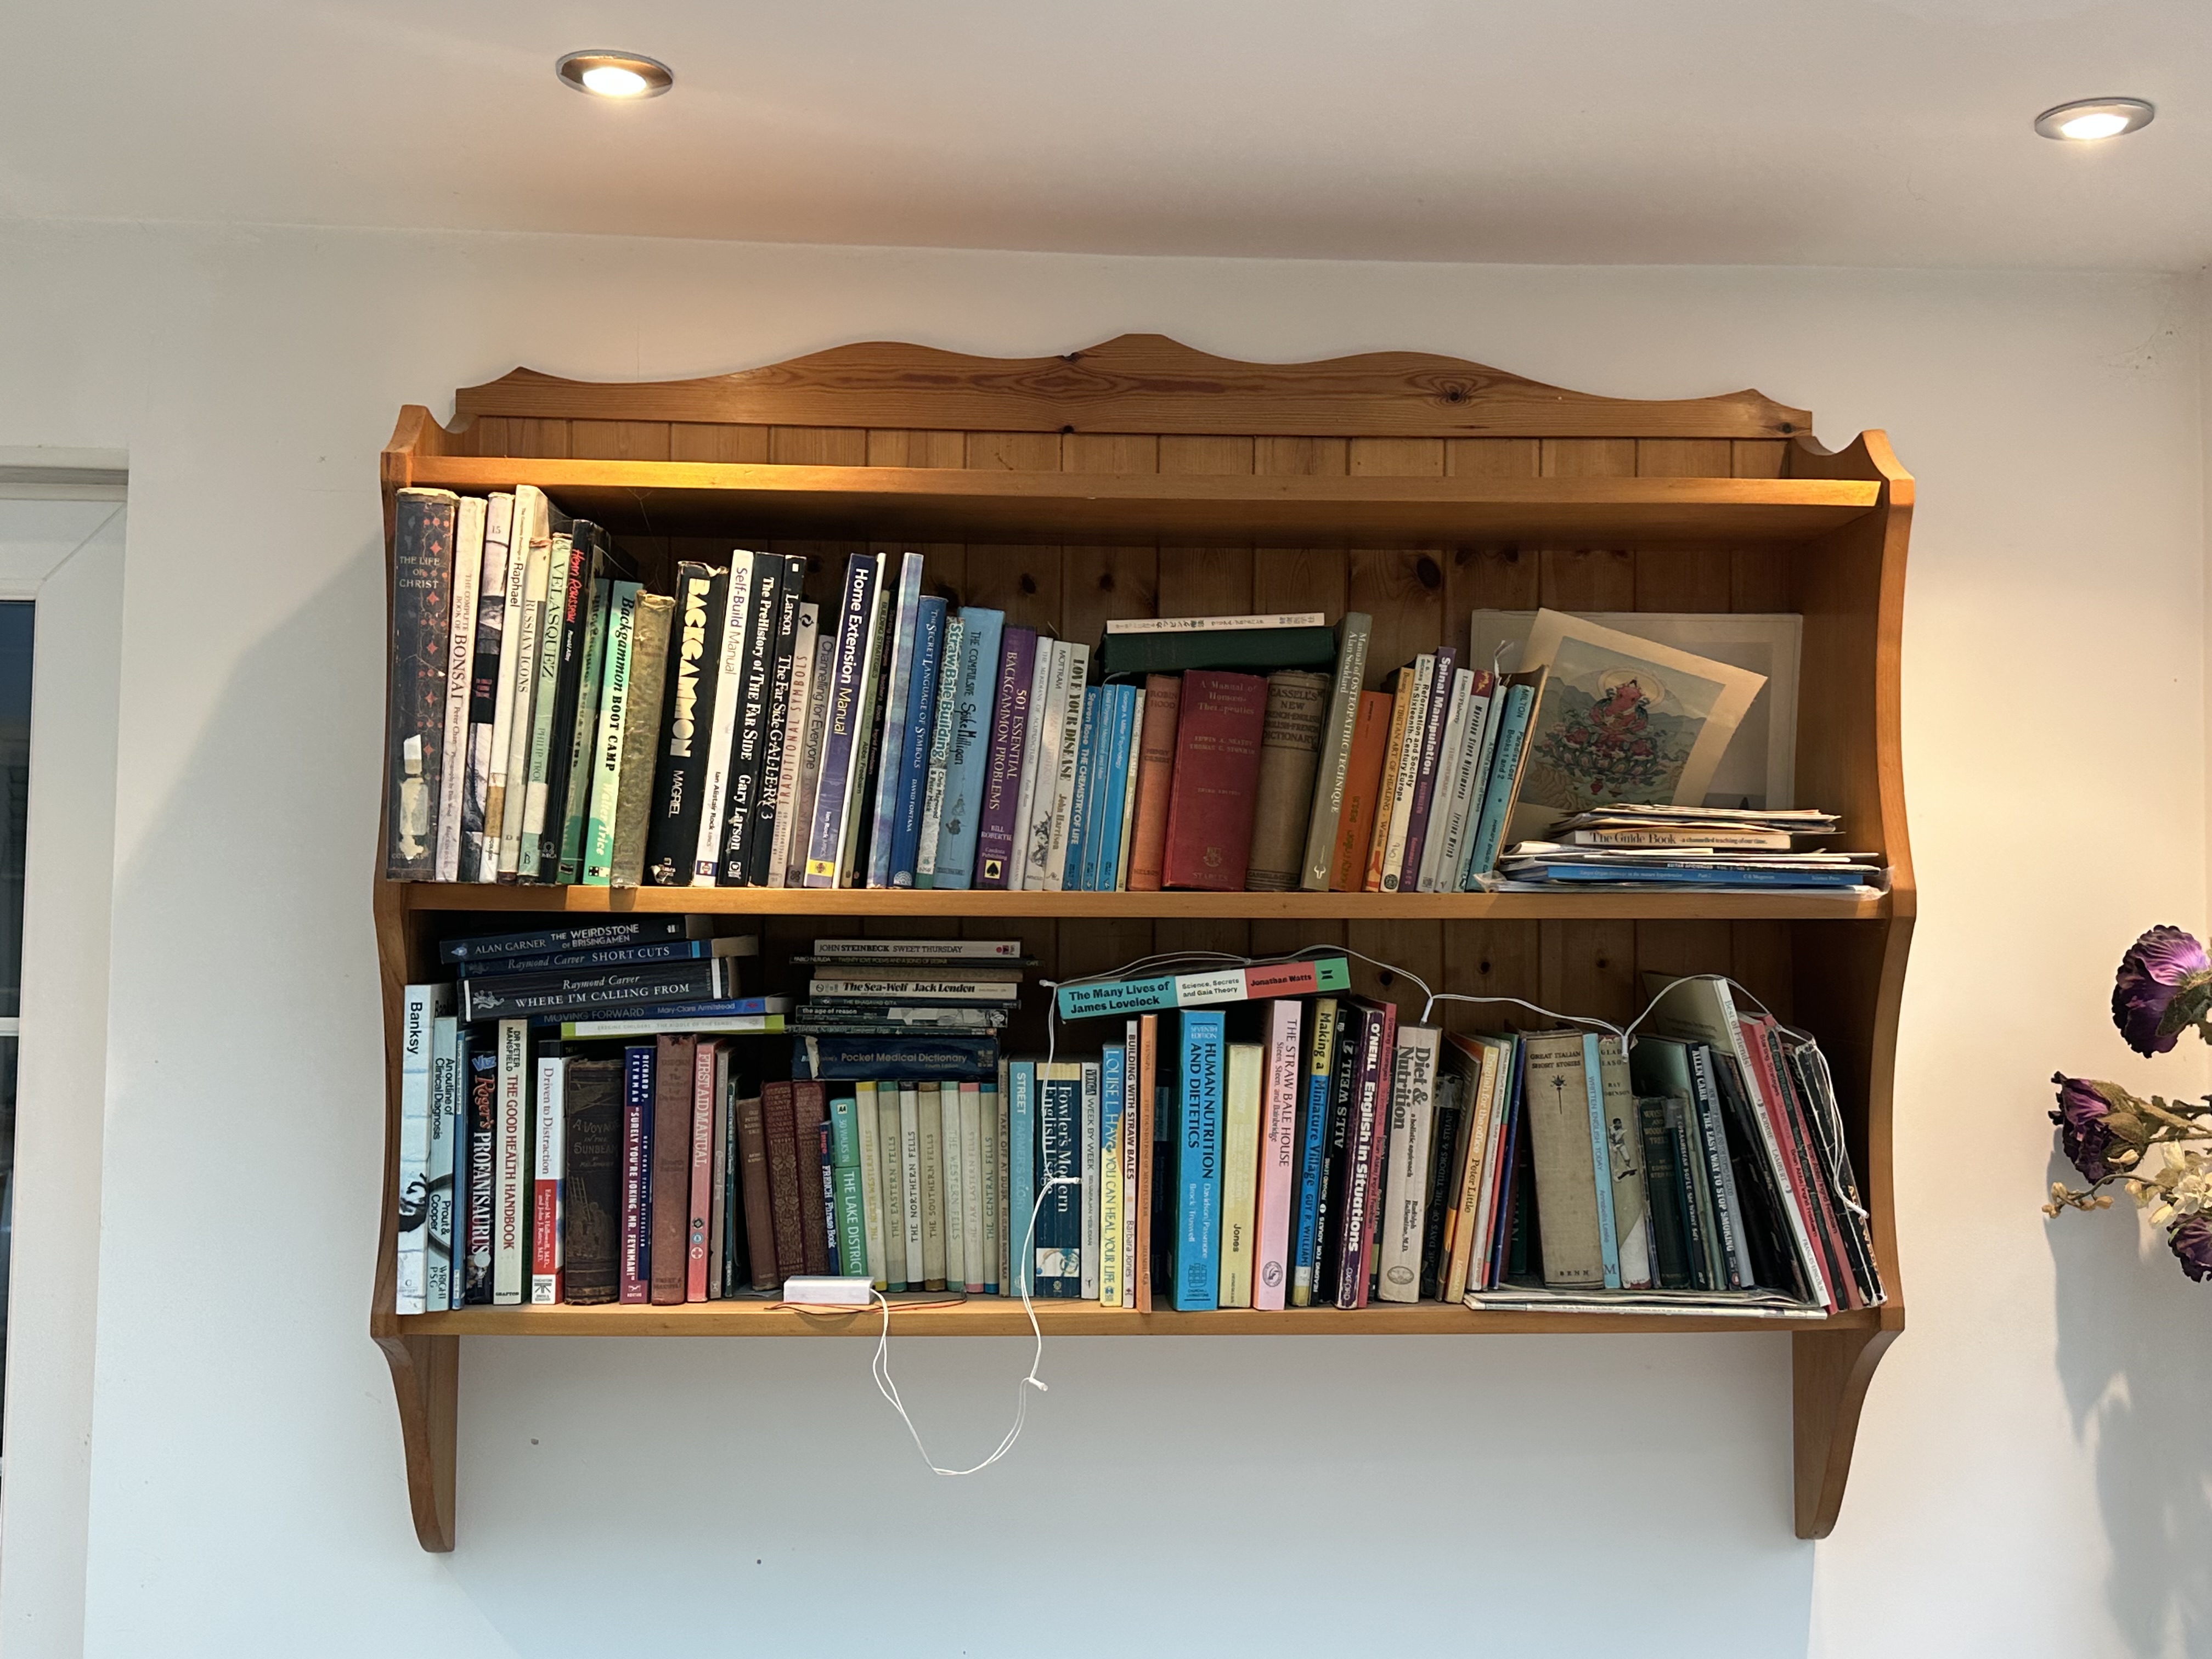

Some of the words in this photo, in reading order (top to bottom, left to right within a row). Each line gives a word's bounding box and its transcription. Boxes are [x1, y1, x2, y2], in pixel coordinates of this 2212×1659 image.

[400, 556, 417, 565] THE
[419, 557, 440, 566] LIFE
[399, 579, 439, 589] CHRIST
[510, 562, 523, 607] Raphael
[730, 567, 748, 628] Self-Build
[850, 568, 869, 612] Home
[455, 621, 461, 630] OF
[522, 600, 536, 650] RUSSIAN
[542, 562, 565, 679] VELASQUEZ
[613, 595, 635, 692] Backgammon
[724, 631, 742, 675] Manual
[840, 615, 862, 684] Extension
[926, 623, 938, 657] SECRET
[451, 634, 467, 699] BONSAI
[518, 656, 531, 693] ICONS
[670, 578, 710, 758] BACKGAMMON
[1055, 650, 1066, 690] MOTTRAM
[1070, 658, 1085, 691] LOVE
[1436, 657, 1451, 695] Spinal
[919, 659, 933, 710] LANGUAGE
[997, 651, 1018, 743] BACKGAMMON
[1015, 689, 1028, 710] 501
[1149, 690, 1177, 699] ROBIN
[1267, 689, 1317, 701] CASSELL'S
[609, 696, 623, 730] BOOT
[833, 688, 851, 736] Manual
[918, 713, 927, 725] OF
[1065, 695, 1081, 725] YOUR
[1150, 700, 1175, 709] HOOD
[1281, 701, 1306, 710] NEW
[1415, 684, 1430, 736] Reformation
[778, 719, 800, 804] TRADITIONAL
[791, 656, 808, 712] SYMBOLS
[1412, 738, 1420, 754] and
[1422, 696, 1444, 775] Manipulation
[605, 735, 619, 771] CAMP
[914, 726, 927, 769] SYMBOLS
[1006, 715, 1024, 780] ESSENTIAL
[1059, 727, 1077, 782] DISEASE
[989, 746, 1007, 811] PROBLEMS
[1406, 755, 1419, 788] Society
[668, 770, 685, 819] MAGRIEL
[733, 775, 752, 805] Gary
[730, 806, 748, 850] Larson
[1590, 832, 1613, 844] The
[1615, 832, 1645, 844] Guide
[1649, 833, 1677, 844] Book
[475, 943, 503, 955] ALAN
[505, 939, 546, 951] GARNER
[550, 932, 567, 941] THE
[570, 923, 640, 939] WEIRDSTONE
[921, 945, 963, 953] THURSDAY
[507, 957, 549, 971] Raymond
[554, 954, 585, 966] Carver
[592, 950, 635, 962] SHORT
[637, 946, 670, 958] CUTS
[515, 995, 564, 1008] WHERE
[567, 993, 587, 1003] I'M
[591, 986, 649, 1002] CALLING
[654, 983, 690, 996] FROM
[843, 982, 864, 991] The
[912, 983, 937, 992] Jack
[938, 983, 976, 993] London
[1069, 991, 1091, 1001] The
[1093, 988, 1124, 999] Many
[1126, 985, 1155, 995] Lives
[1158, 981, 1171, 991] of
[1182, 981, 1212, 990] Science,
[1213, 978, 1240, 986] Secrets
[1214, 986, 1238, 995] Theory
[1250, 977, 1288, 987] Jonathan
[1289, 974, 1312, 982] Watts
[1070, 1002, 1107, 1014] James
[1109, 996, 1160, 1009] Lovelock
[1724, 999, 1737, 1020] Best
[407, 1002, 422, 1055] Banksy
[1285, 1019, 1297, 1042] THE
[1731, 1020, 1741, 1030] of
[505, 1026, 514, 1072] MANSFIELD
[841, 1053, 874, 1063] Pocket
[877, 1053, 916, 1063] Medical
[918, 1053, 967, 1064] Dictionary
[1128, 1035, 1136, 1081] BUILDING
[1190, 1043, 1201, 1074] AND
[1367, 1023, 1380, 1071] O'NEILL
[1554, 1051, 1582, 1059] ITALIAN
[1692, 1049, 1702, 1077] ALLEN
[1734, 1031, 1752, 1069] Friends!
[433, 1058, 445, 1095] Clinical
[631, 1054, 640, 1103] FEYNMAN
[697, 1053, 711, 1088] FIRST
[1205, 1043, 1216, 1097] HUMAN
[1283, 1046, 1296, 1089] STRAW
[1413, 1047, 1431, 1085] Diet
[1531, 1062, 1555, 1070] SHORT
[1556, 1060, 1582, 1068] STORIES
[506, 1075, 518, 1098] THE
[543, 1067, 554, 1101] Driven
[696, 1090, 709, 1111] AID
[1393, 1045, 1415, 1130] Nutrition
[1412, 1087, 1429, 1105] &
[1588, 1076, 1598, 1109] WRITTEN
[1696, 1077, 1708, 1101] CARR
[433, 1096, 444, 1140] Diagnosis
[472, 1074, 495, 1130] Roger's
[506, 1099, 518, 1133] GOOD
[543, 1102, 551, 1115] to
[1188, 1079, 1201, 1149] DIETETICS
[1281, 1093, 1294, 1123] BALE
[1360, 1081, 1376, 1143] English
[1127, 1111, 1135, 1146] STRAW
[1591, 1111, 1600, 1143] ENGLISH
[1703, 1110, 1712, 1129] THE
[542, 1117, 554, 1174] Distraction
[694, 1111, 709, 1167] MANUAL
[1202, 1100, 1216, 1179] NUTRITION
[1279, 1126, 1291, 1167] HOUSE
[1358, 1145, 1371, 1161] in
[1706, 1131, 1717, 1152] EASY
[505, 1135, 517, 1180] HEALTH
[1126, 1149, 1135, 1180] BALES
[1468, 1158, 1480, 1185] Peter
[1595, 1147, 1603, 1171] TODAY
[1709, 1154, 1720, 1174] WAY
[472, 1132, 492, 1255] PROFANISAURUS
[843, 1171, 856, 1193] THE
[909, 1164, 918, 1218] NORTHERN
[1713, 1175, 1723, 1187] TO
[430, 1194, 441, 1231] Cooper
[845, 1197, 858, 1223] LAKE
[1348, 1163, 1368, 1252] Situations
[1464, 1186, 1476, 1214] Little
[1716, 1188, 1727, 1210] STOP
[503, 1183, 516, 1250] HANDBOOK
[911, 1223, 919, 1243] THE
[1720, 1211, 1735, 1252] SMOKING
[847, 1226, 862, 1274] DISTRICT
[1126, 1220, 1135, 1252] Barbara
[1125, 1255, 1134, 1278] Jones
